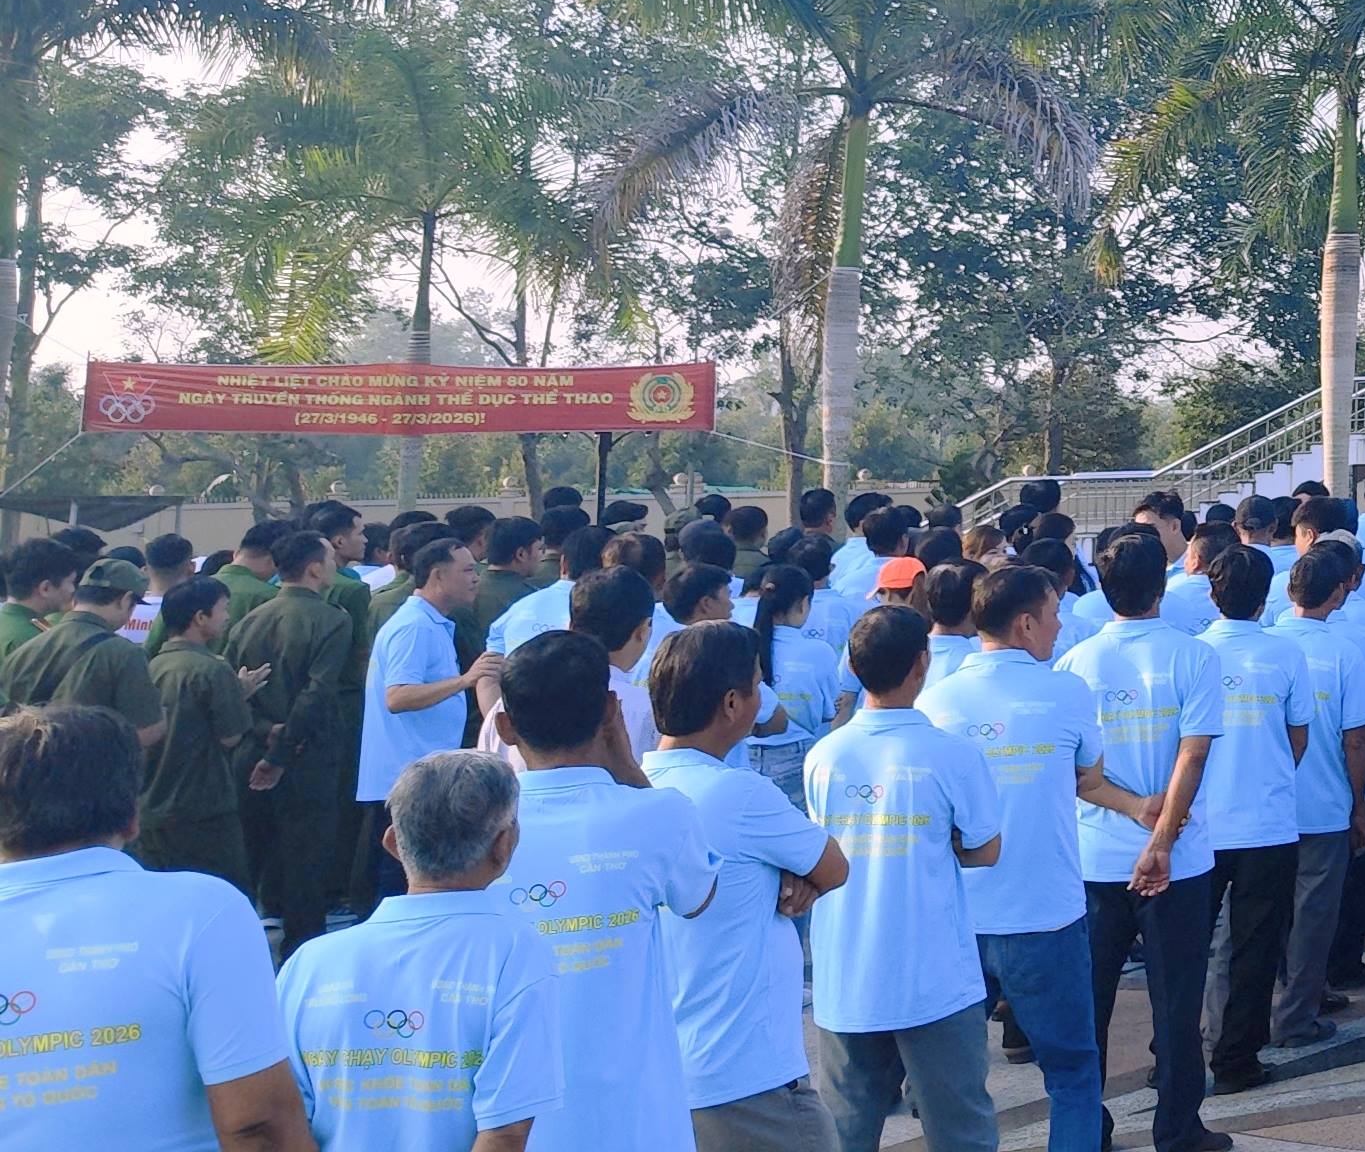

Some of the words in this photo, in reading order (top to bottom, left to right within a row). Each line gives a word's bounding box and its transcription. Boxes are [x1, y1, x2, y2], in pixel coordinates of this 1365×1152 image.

[216, 374, 274, 389] NHIỆT
[274, 374, 312, 389] LIỆT
[316, 373, 362, 387] CHÀO
[368, 373, 418, 387] MỪNG
[455, 374, 504, 389] NIỆM
[506, 375, 528, 387] 80
[533, 373, 574, 387] NĂM
[178, 390, 226, 405] NGÀY
[368, 390, 431, 405] NGÀNH
[478, 393, 516, 407] DỤC
[564, 392, 614, 405] THAO
[295, 412, 377, 426] (27/3/1946
[391, 412, 486, 426] 27/3/2026)!
[537, 913, 603, 935] OLYMPIC
[608, 908, 640, 928] 2026
[91, 1023, 142, 1048] 2026
